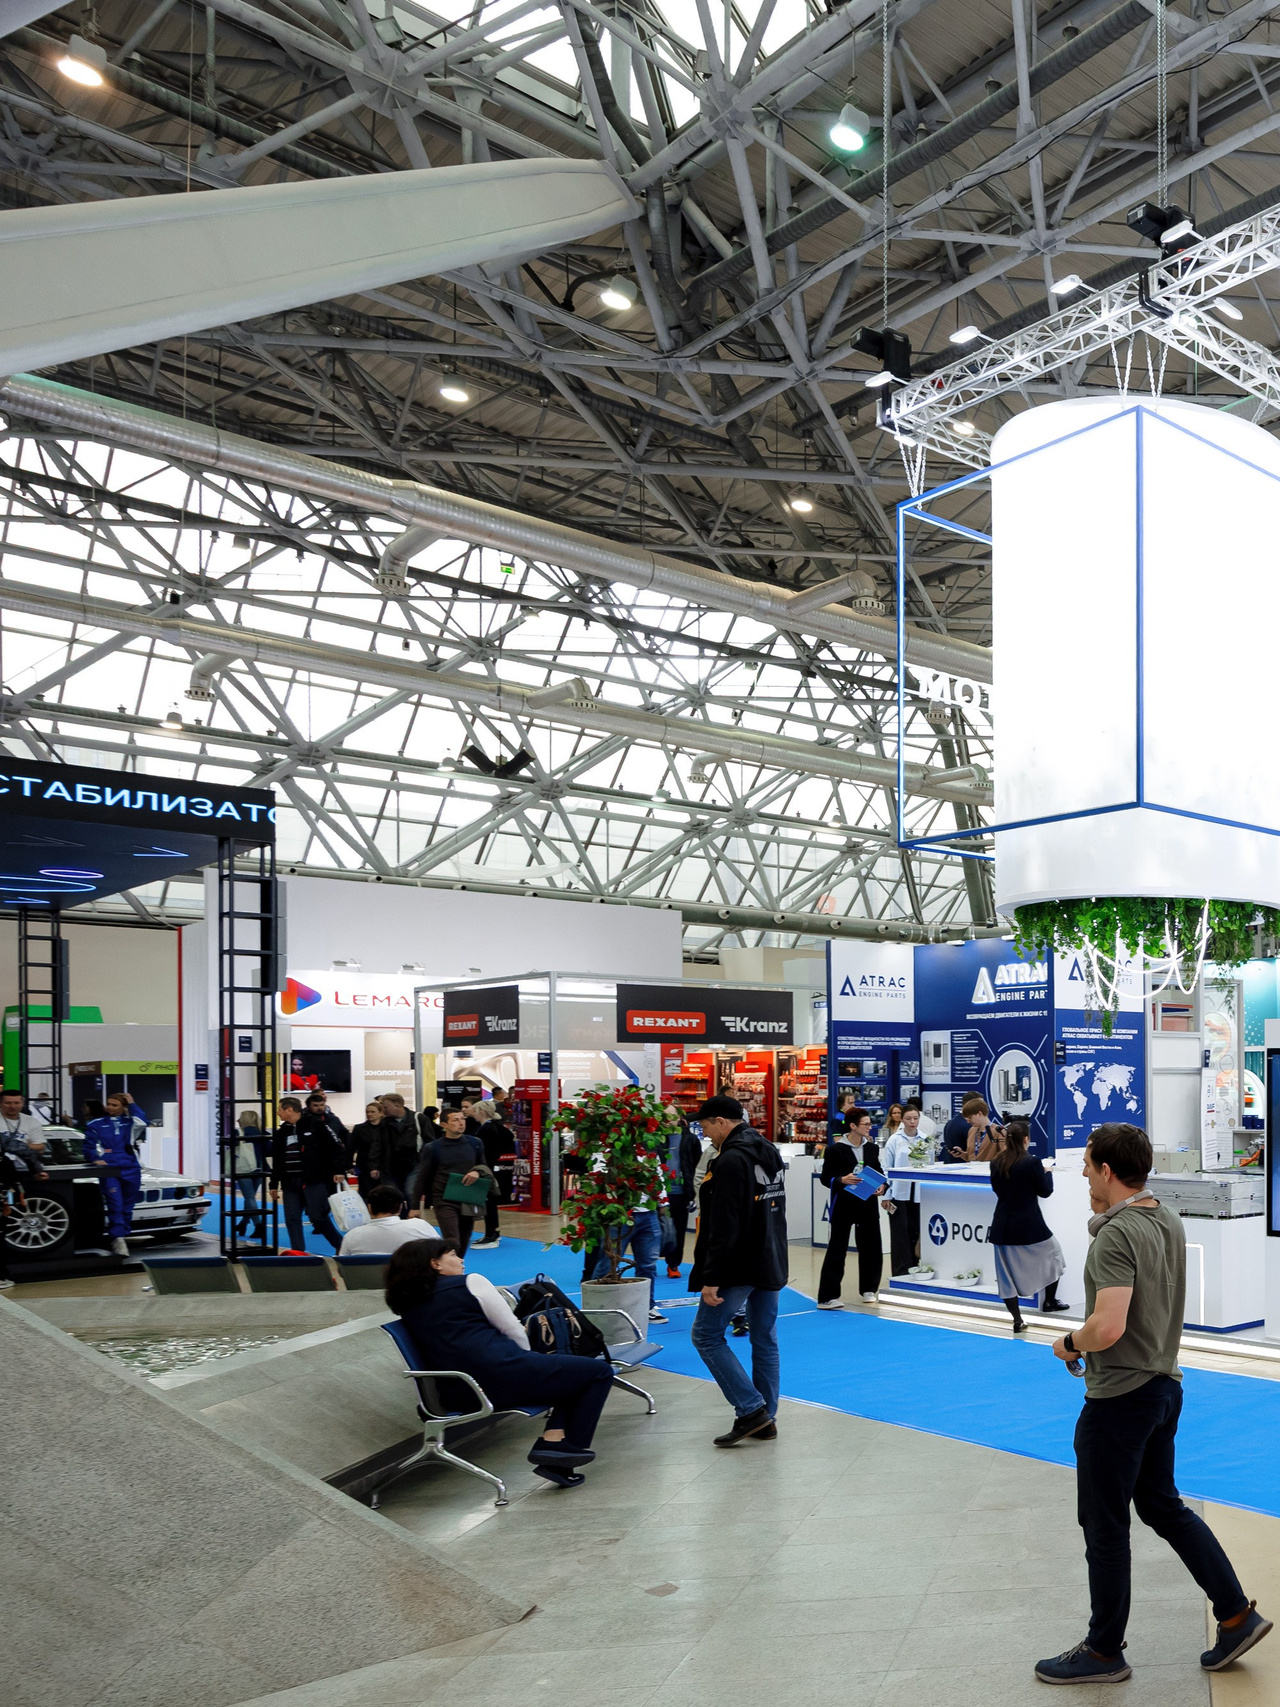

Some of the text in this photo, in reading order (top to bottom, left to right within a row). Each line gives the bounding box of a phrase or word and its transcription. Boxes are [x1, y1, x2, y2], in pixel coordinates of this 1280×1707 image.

[859, 975, 906, 988] ATRAC
[996, 991, 1025, 1001] ENGINE
[448, 1015, 517, 1032] REXANT Kranz
[633, 1016, 788, 1033] REXANT Kranz
